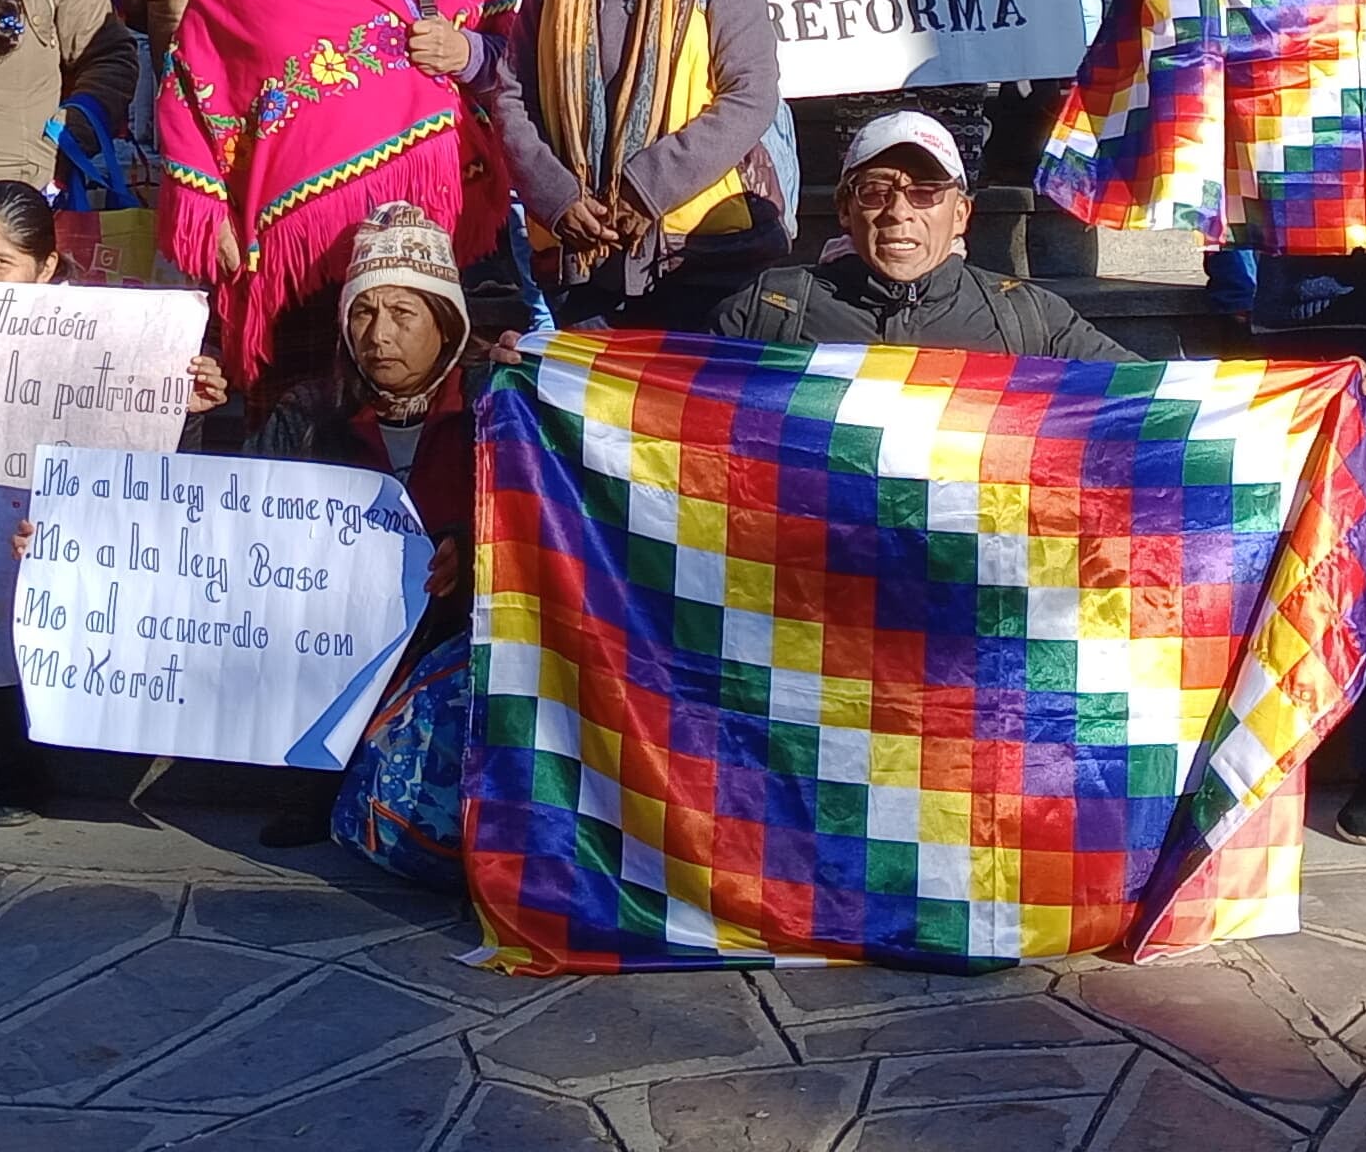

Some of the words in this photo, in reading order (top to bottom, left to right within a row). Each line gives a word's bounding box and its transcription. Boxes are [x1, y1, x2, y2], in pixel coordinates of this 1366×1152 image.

[4, 350, 42, 407] la
[4, 452, 27, 479] a
[91, 478, 111, 499] a
[122, 453, 149, 501] la
[160, 456, 204, 524] ley
[220, 473, 251, 514] de
[96, 544, 115, 569] a
[129, 522, 160, 573] la
[178, 526, 228, 604] ley
[248, 542, 330, 591] Base
[84, 581, 119, 635] al
[136, 610, 269, 650] acuerdo
[295, 629, 354, 657] con
